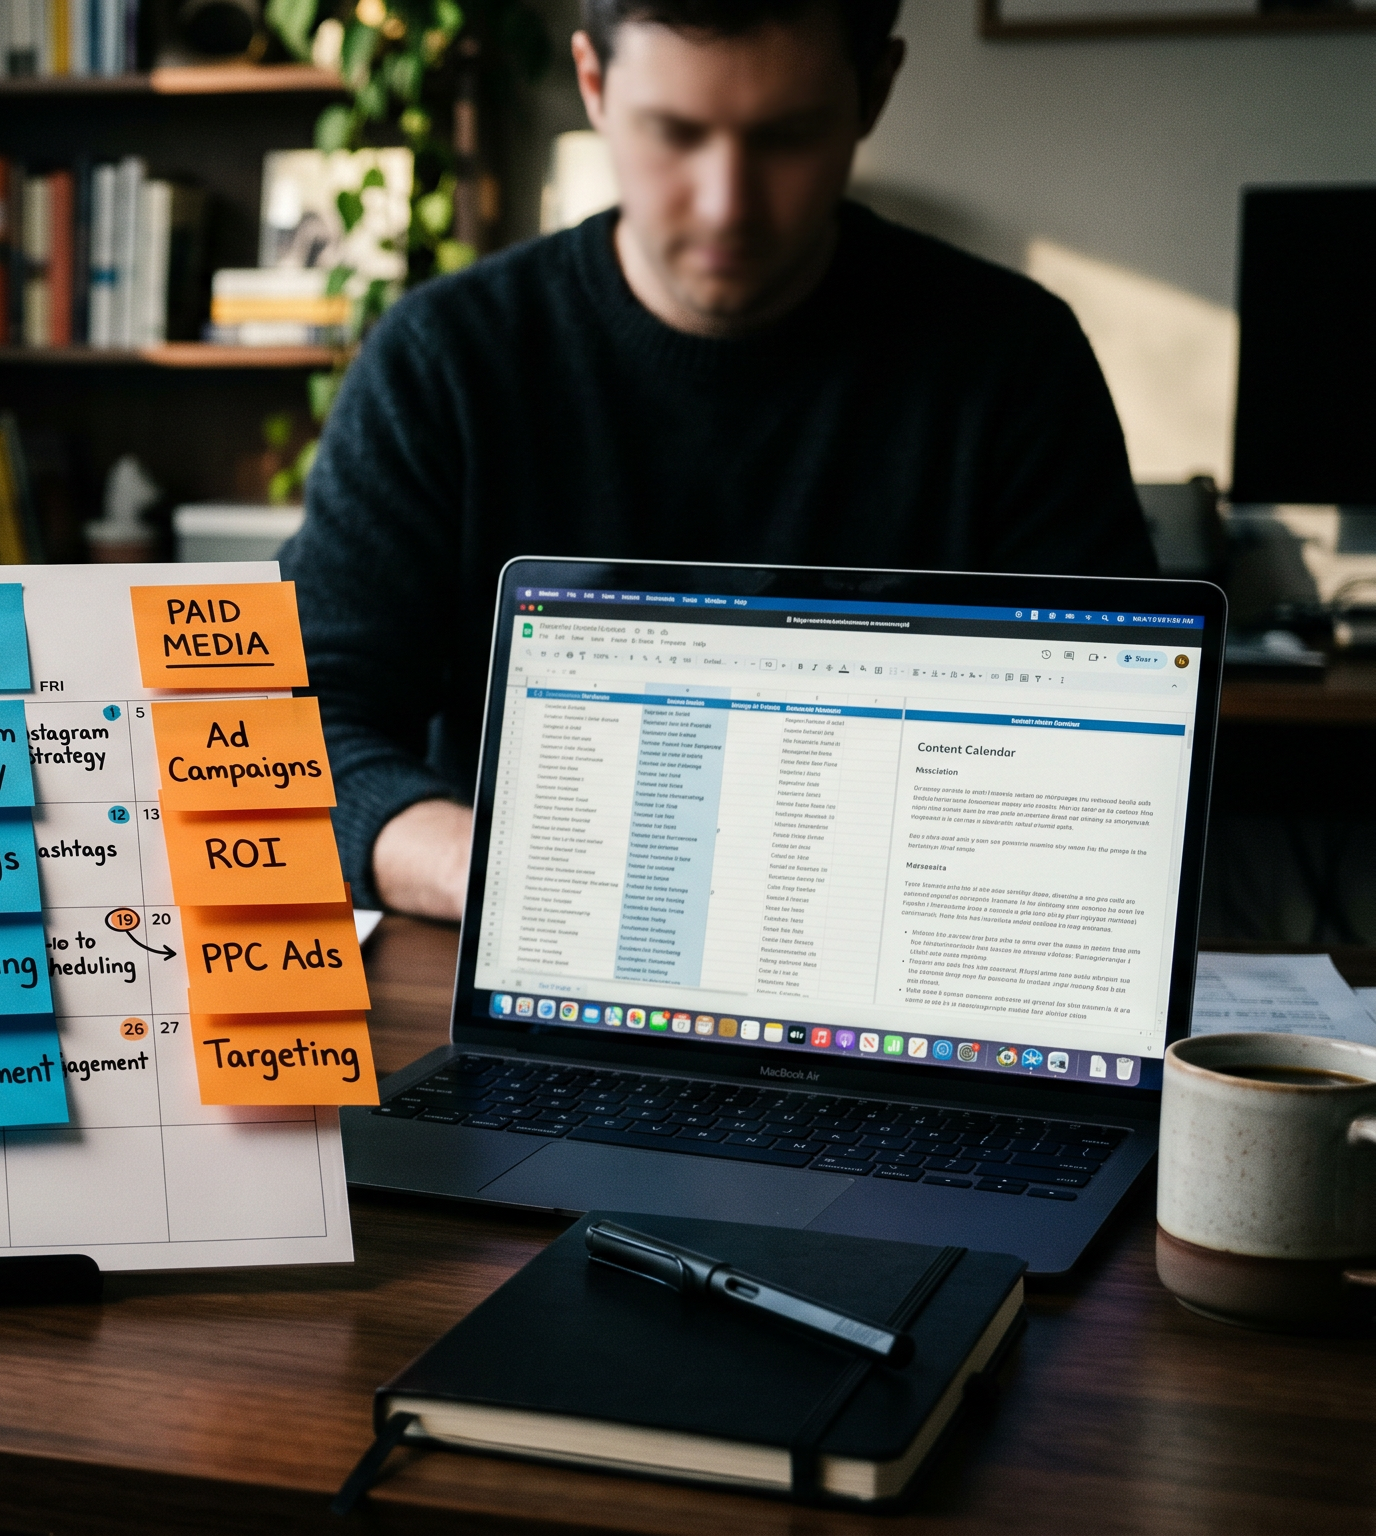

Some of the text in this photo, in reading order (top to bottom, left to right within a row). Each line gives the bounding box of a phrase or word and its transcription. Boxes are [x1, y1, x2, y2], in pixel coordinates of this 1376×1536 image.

[166, 598, 241, 625] PAID
[163, 631, 270, 658] MEDIA
[39, 680, 64, 692] FRI
[135, 706, 145, 719] 5
[27, 722, 109, 749] stagram
[206, 720, 250, 749] Ad
[917, 742, 1016, 757] Content Calendar
[168, 756, 322, 790] Campaigns
[110, 808, 127, 821] 12
[143, 808, 160, 821] 13
[38, 841, 118, 866] ashtags
[204, 837, 287, 870] ROI
[117, 913, 134, 927] 19
[151, 912, 172, 926] 20
[74, 930, 97, 950] to
[201, 938, 343, 974] PPC Ads
[49, 956, 137, 983] heduling
[123, 1022, 145, 1036] 26
[160, 1021, 180, 1034] 27
[202, 1037, 361, 1083] Targeting
[806, 1071, 820, 1081] Air
